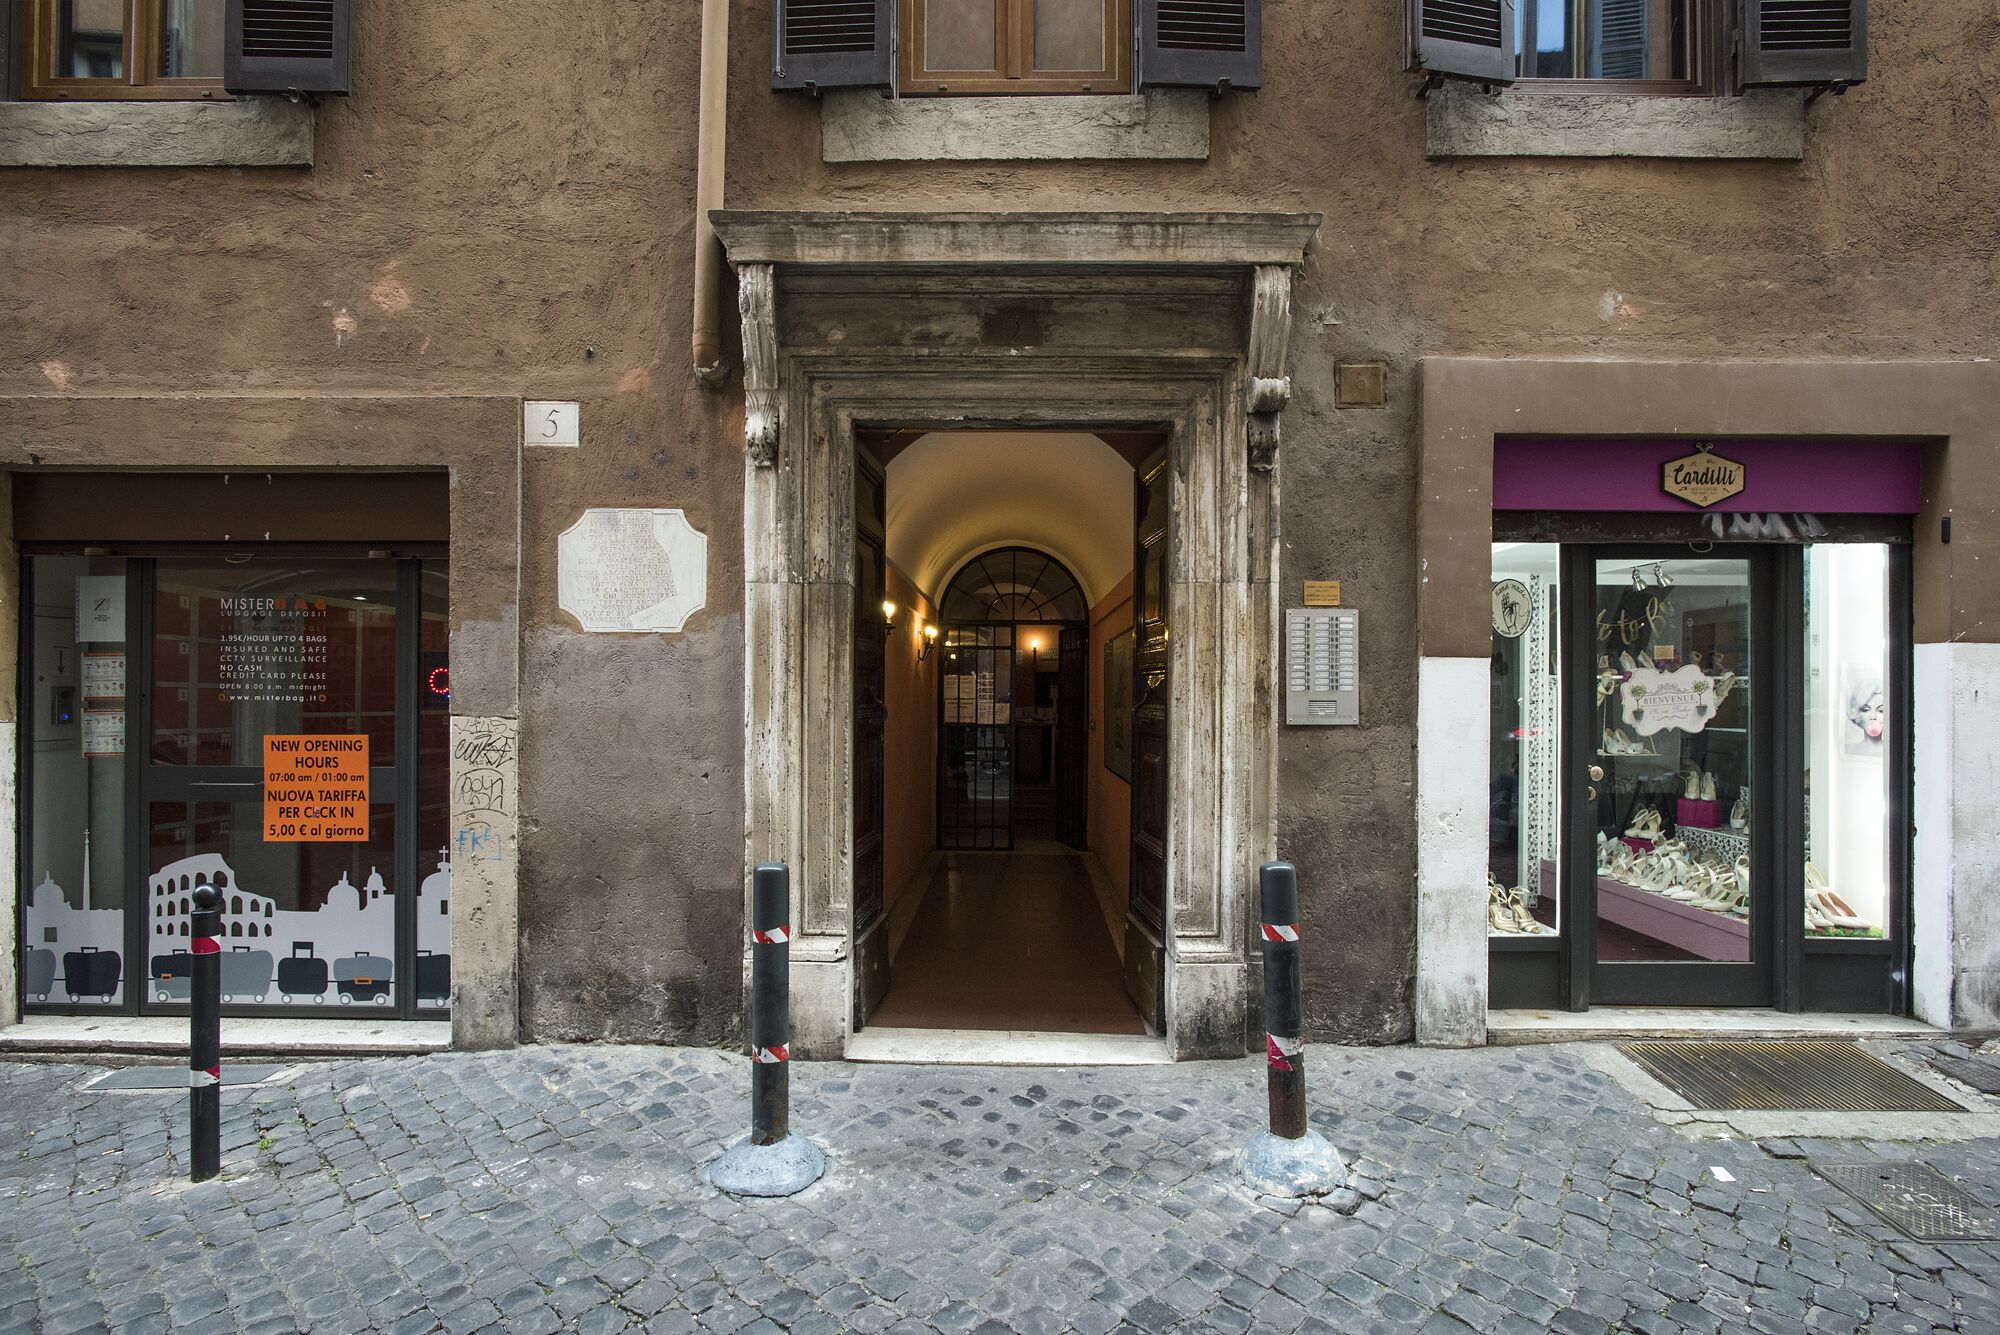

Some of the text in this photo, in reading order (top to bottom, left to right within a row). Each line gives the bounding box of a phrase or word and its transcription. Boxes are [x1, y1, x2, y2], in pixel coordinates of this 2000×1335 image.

[542, 409, 560, 438] 5
[1673, 464, 1736, 485] Cardilli
[220, 634, 270, 643] 1.95€/HOUR
[298, 635, 303, 643] 4
[305, 635, 327, 643] BAGS
[251, 655, 327, 663] SURVEILLANCE
[291, 672, 326, 680] PLEASE
[289, 683, 326, 691] midnight
[229, 694, 317, 702] www.misterbag.it
[1643, 694, 1693, 705] BIENVENUE
[271, 740, 363, 752] NEW OPENING
[295, 757, 339, 768] HOURS
[269, 772, 365, 783] 07:00 am / 01:00 am
[267, 790, 366, 802] NUOVA TARIFFA
[279, 807, 300, 818] PER
[340, 807, 354, 818] IN
[269, 824, 364, 839] 5,00 € al giorno
